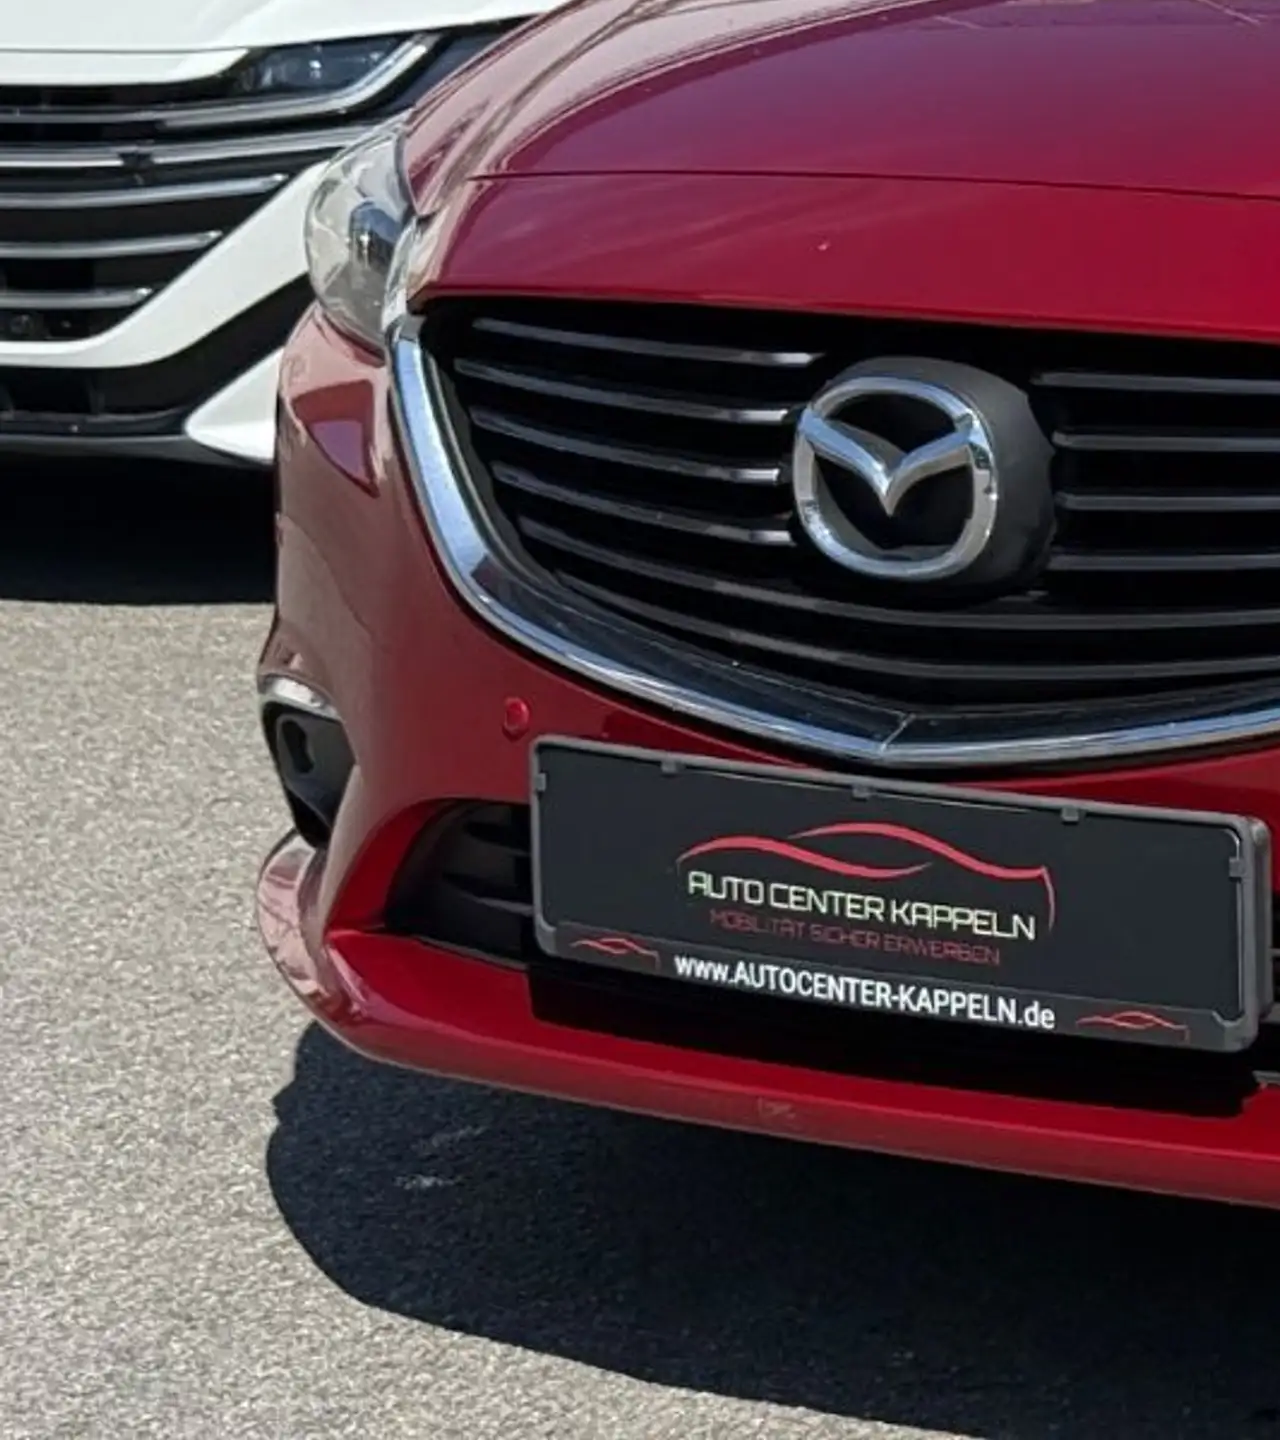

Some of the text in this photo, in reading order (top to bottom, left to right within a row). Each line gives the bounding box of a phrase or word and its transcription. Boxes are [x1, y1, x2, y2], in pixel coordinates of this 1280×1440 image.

[689, 871, 1036, 941] AUTO CENTER KAPPELN
[810, 922, 879, 951] SICHER
[883, 931, 1001, 965] ERWERBEN
[675, 954, 1055, 1029] www.AUTOCENTER-KAPPELN.de
